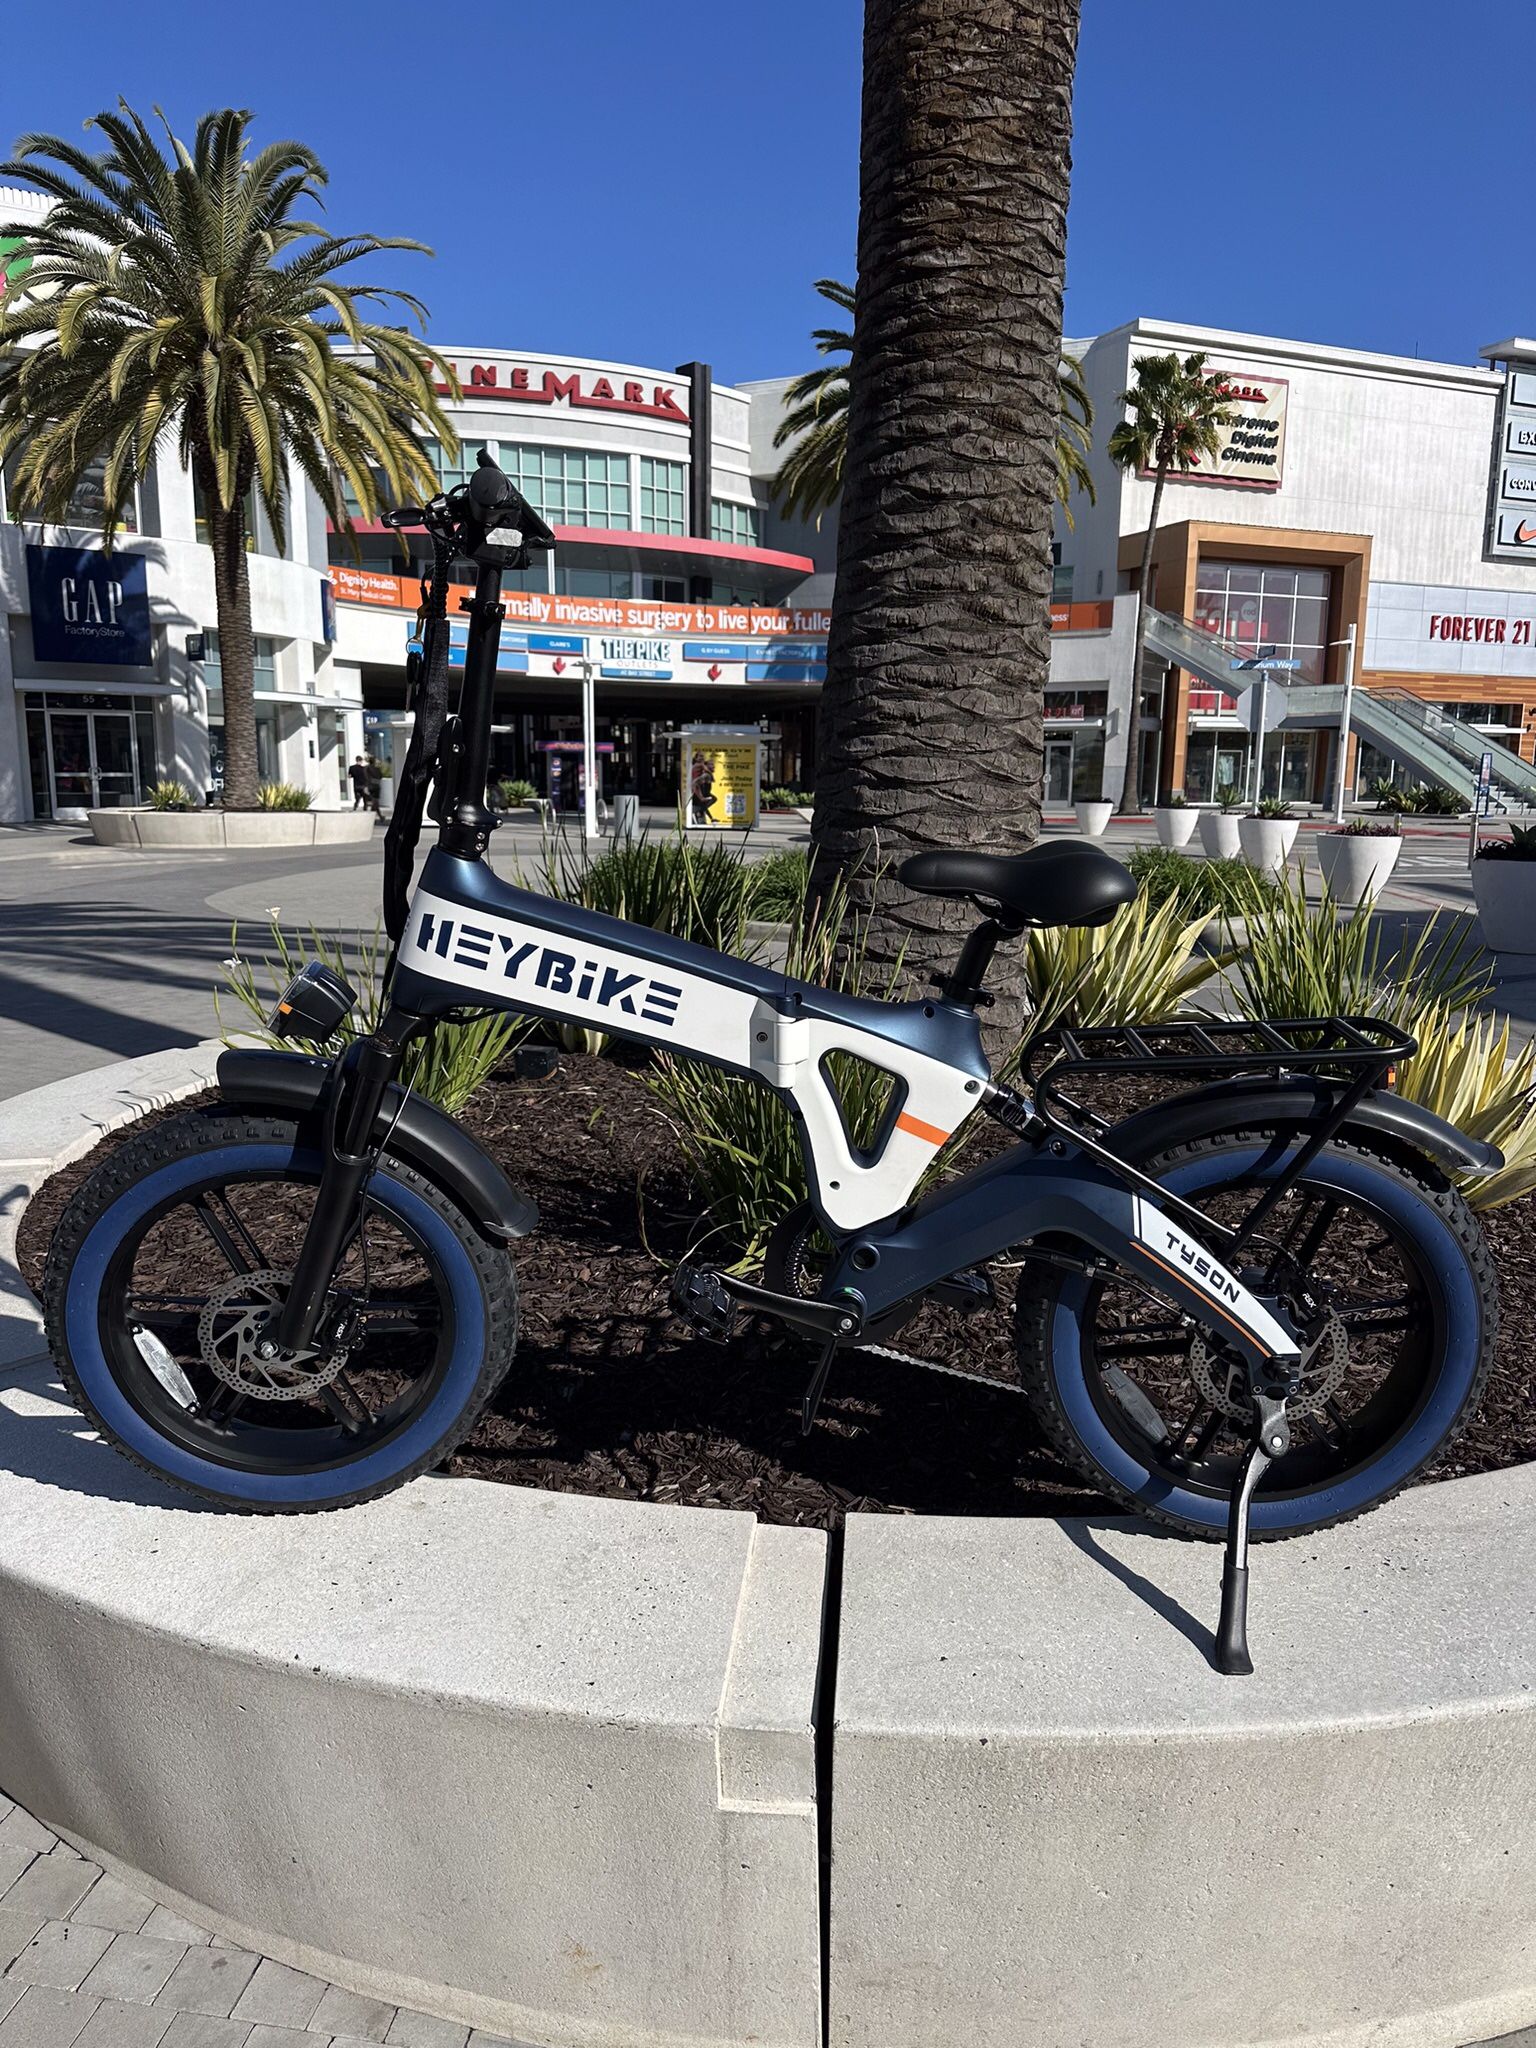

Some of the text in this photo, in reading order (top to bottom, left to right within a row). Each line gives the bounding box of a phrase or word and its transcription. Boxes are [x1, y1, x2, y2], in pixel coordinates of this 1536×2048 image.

[416, 359, 691, 422] NEMARK
[1231, 431, 1279, 449] Digital
[1518, 430, 1536, 446] EX
[1221, 447, 1277, 466] Cinema
[339, 571, 368, 589] Dignity
[61, 577, 123, 625] GAP
[555, 598, 623, 624] invasive
[628, 607, 692, 632] surgery
[696, 609, 714, 629] to
[718, 610, 747, 631] live
[751, 615, 790, 634] your
[793, 611, 831, 632] fulle
[1430, 615, 1530, 645] FOREVER 21
[601, 638, 671, 663] THE PIKE
[617, 660, 658, 669] OUTLETS
[1276, 660, 1296, 669] Way
[1165, 1231, 1241, 1304] TYSON
